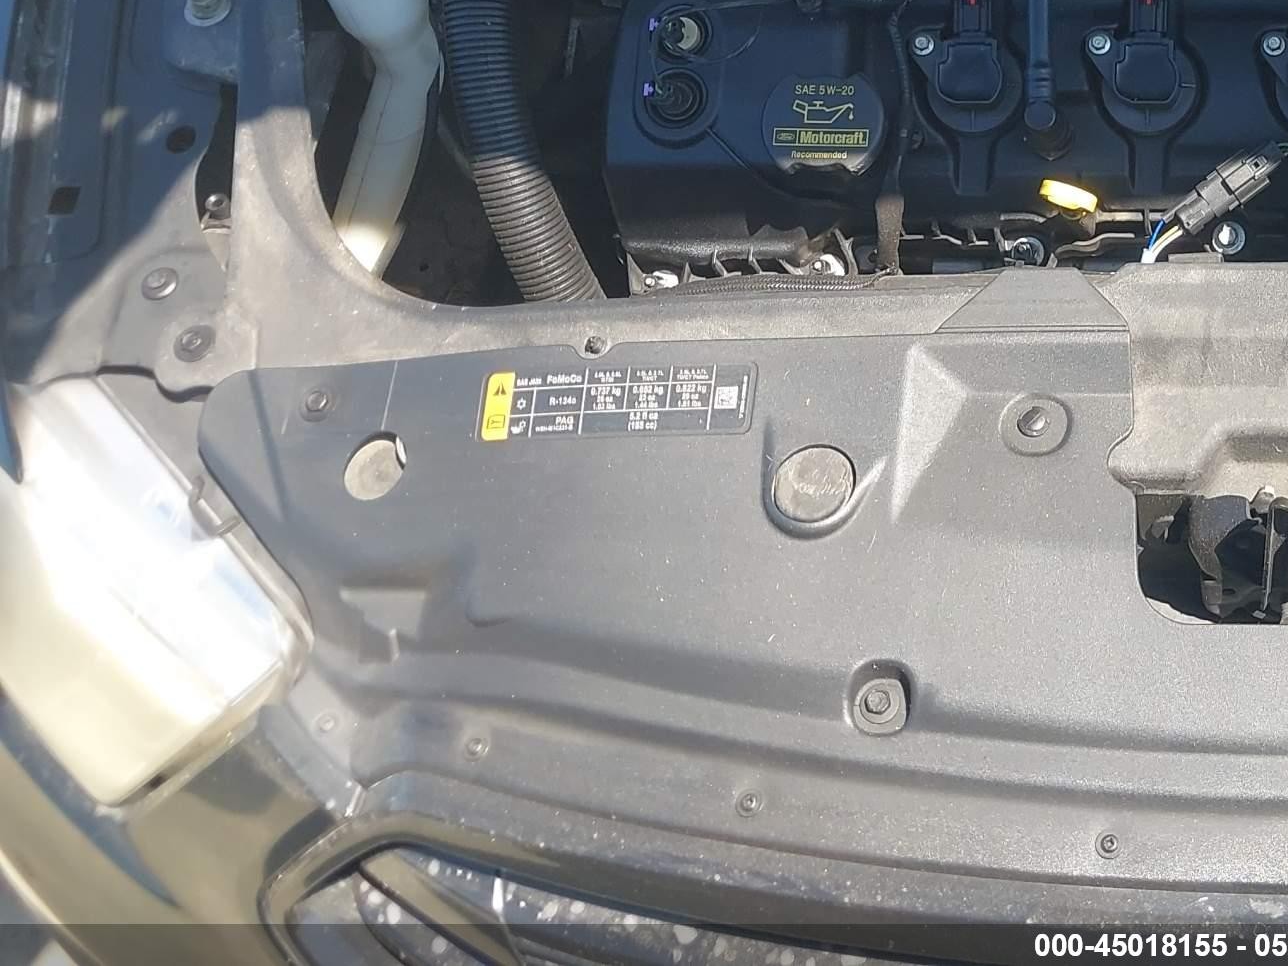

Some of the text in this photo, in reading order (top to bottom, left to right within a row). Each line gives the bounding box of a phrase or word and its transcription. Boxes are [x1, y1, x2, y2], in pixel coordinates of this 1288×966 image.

[795, 84, 855, 96] SAE 5W-20
[791, 150, 848, 160] Recommended
[546, 373, 583, 385] FoMoCo
[611, 386, 622, 397] kg
[653, 385, 664, 395] kg
[696, 384, 707, 394] kg
[555, 416, 574, 425] PAG
